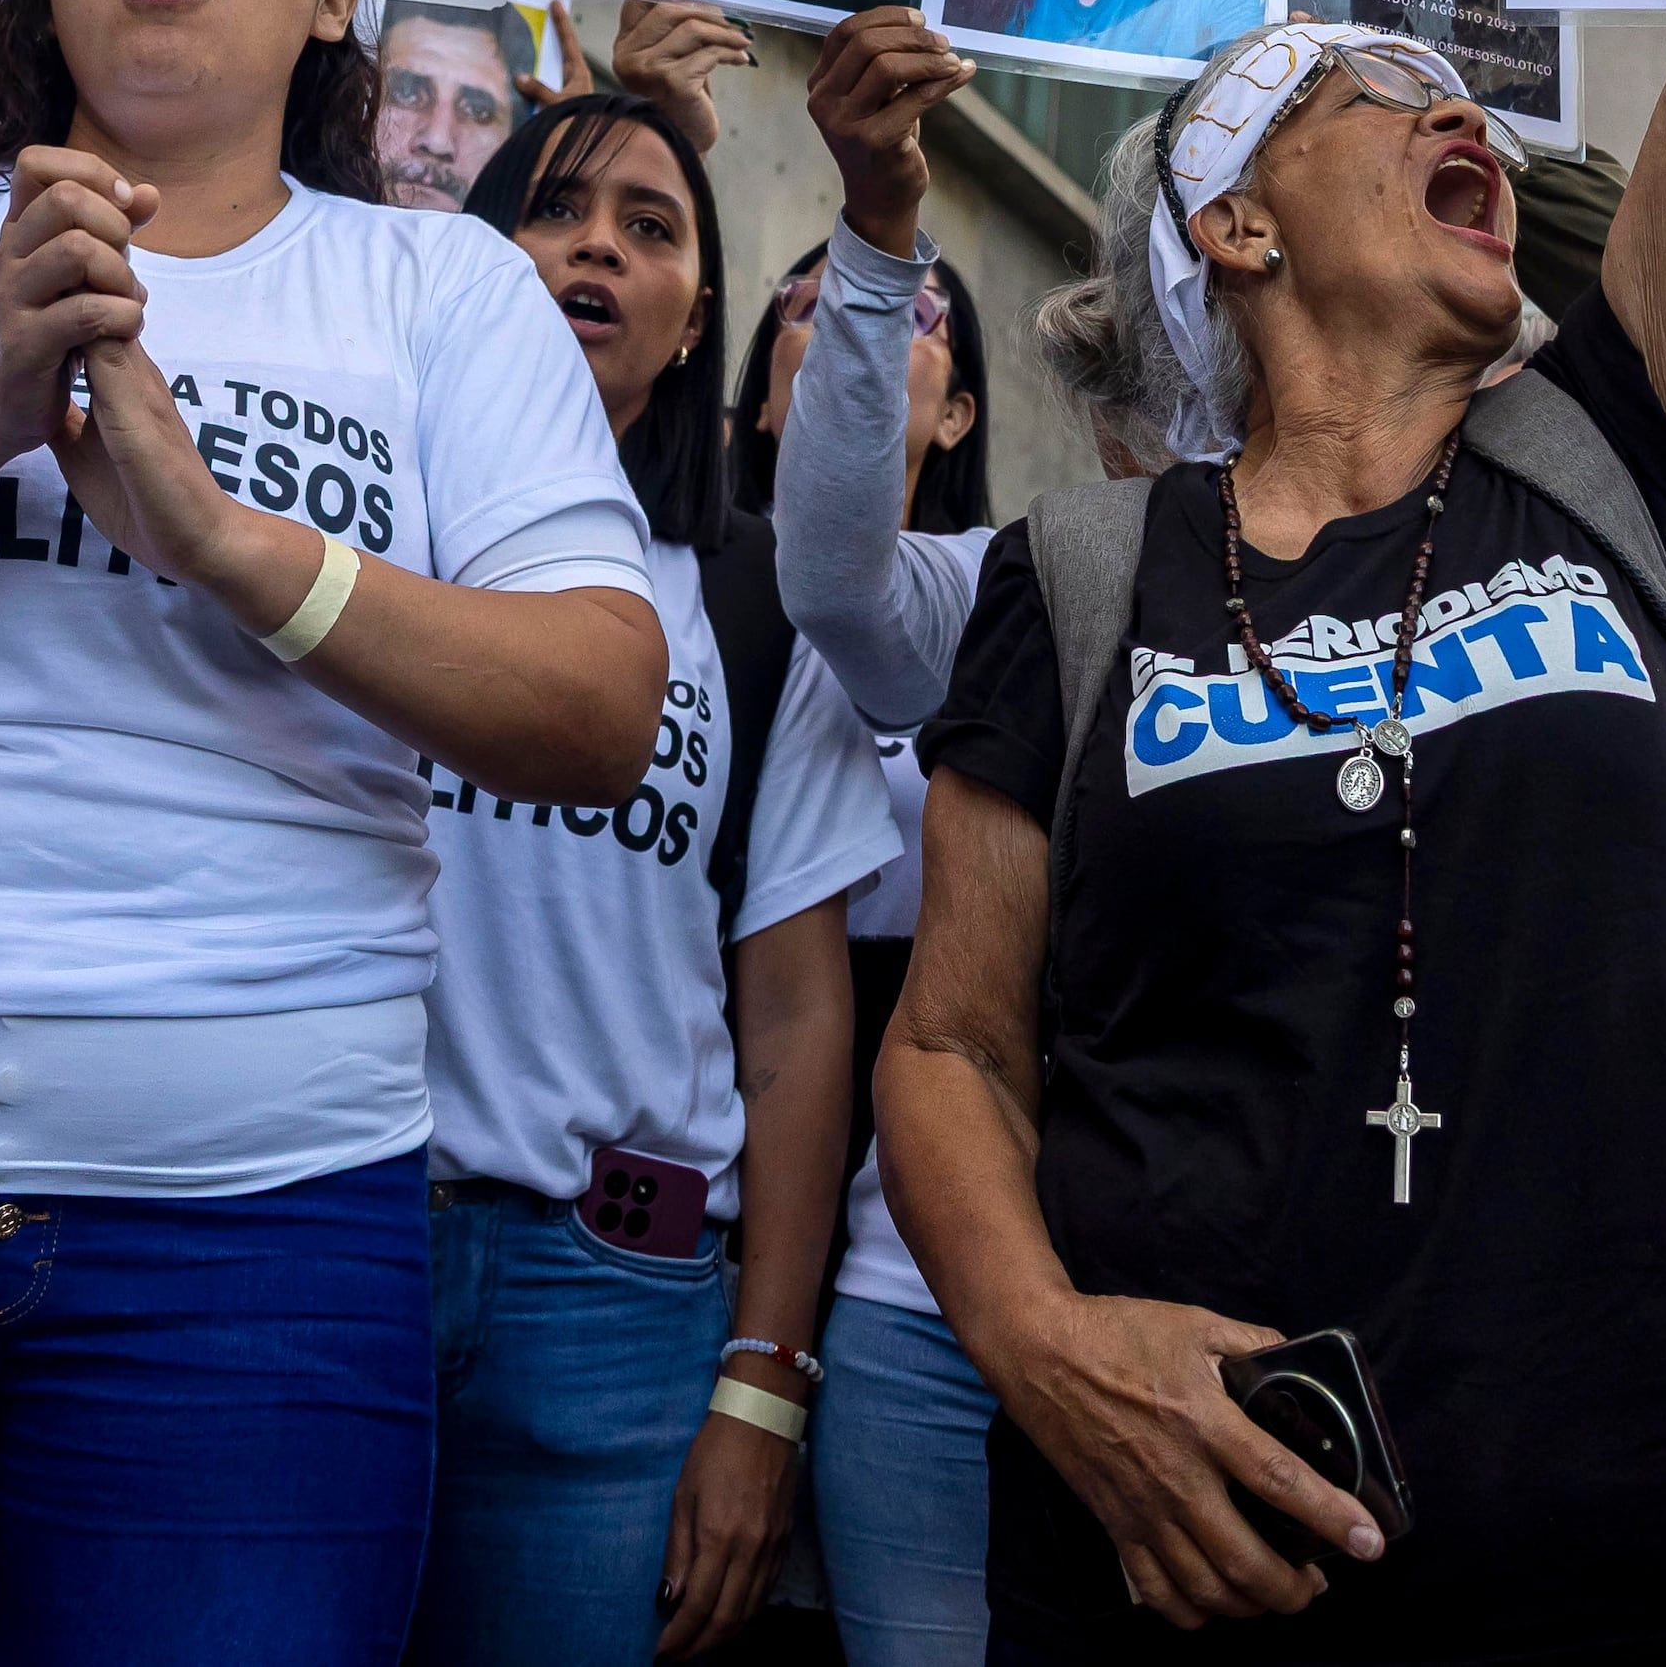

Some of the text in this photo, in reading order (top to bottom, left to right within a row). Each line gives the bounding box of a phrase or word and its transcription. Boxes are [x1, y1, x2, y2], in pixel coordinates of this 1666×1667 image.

[1430, 2, 1483, 25] AGOSTO
[223, 379, 394, 476] TODOS
[196, 421, 395, 555] ESOS
[1132, 600, 1647, 767] CUENTA
